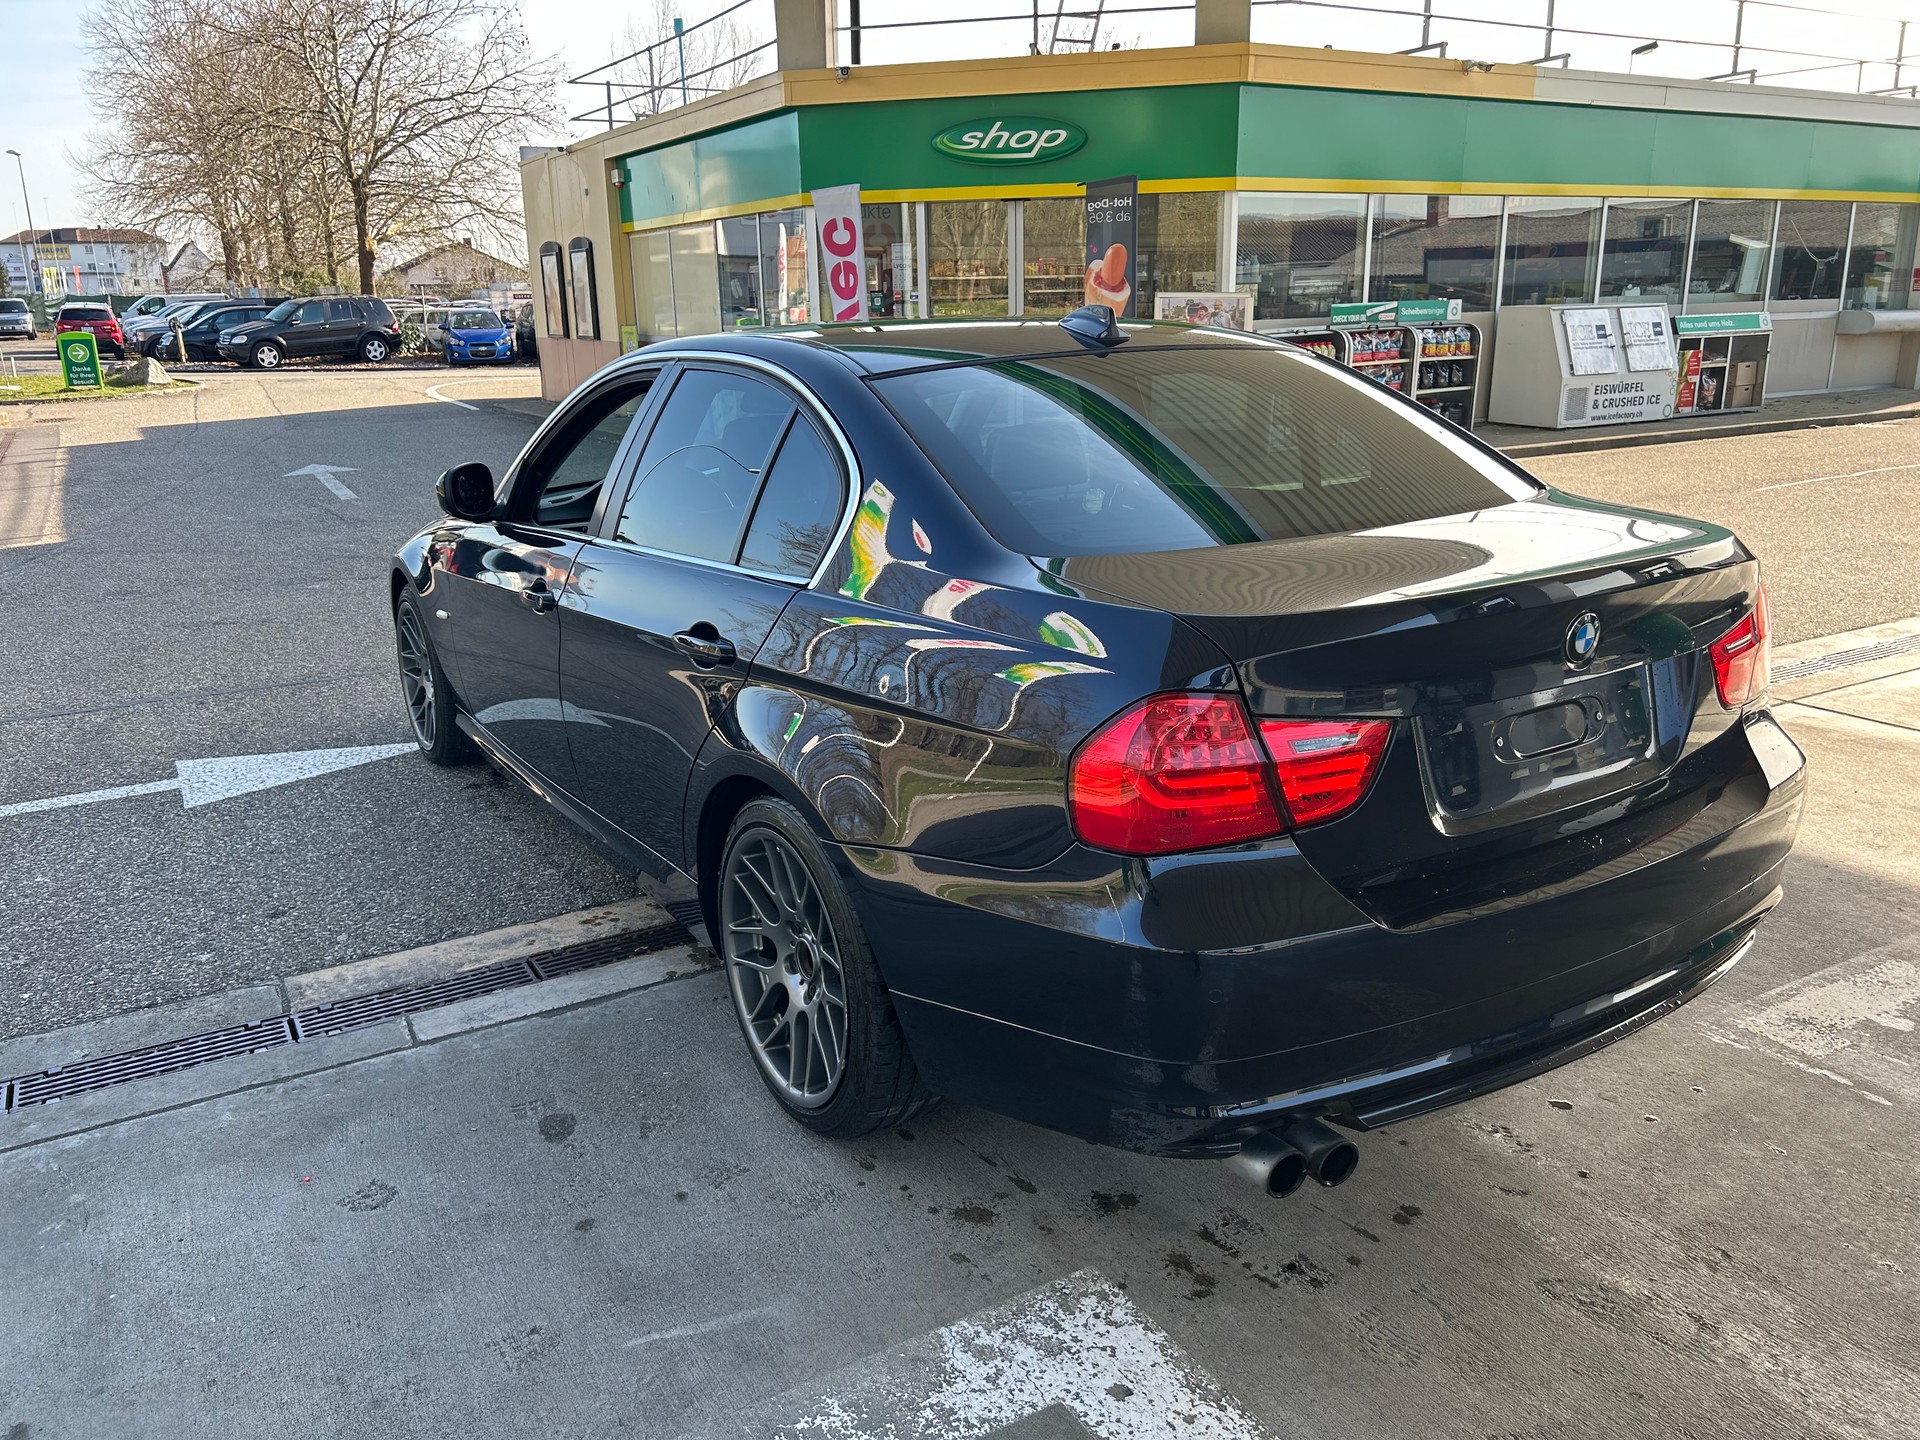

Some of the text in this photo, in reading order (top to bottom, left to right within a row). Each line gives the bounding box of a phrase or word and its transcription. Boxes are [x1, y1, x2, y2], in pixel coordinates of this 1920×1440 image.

[960, 121, 1067, 158] shop
[1569, 325, 1595, 341] ICE
[1628, 322, 1652, 339] ICE
[1594, 381, 1645, 395] EISWÜRFEL
[1592, 394, 1661, 410] & CRUSHED ICE
[1590, 411, 1643, 421] www.icefactory.ch
